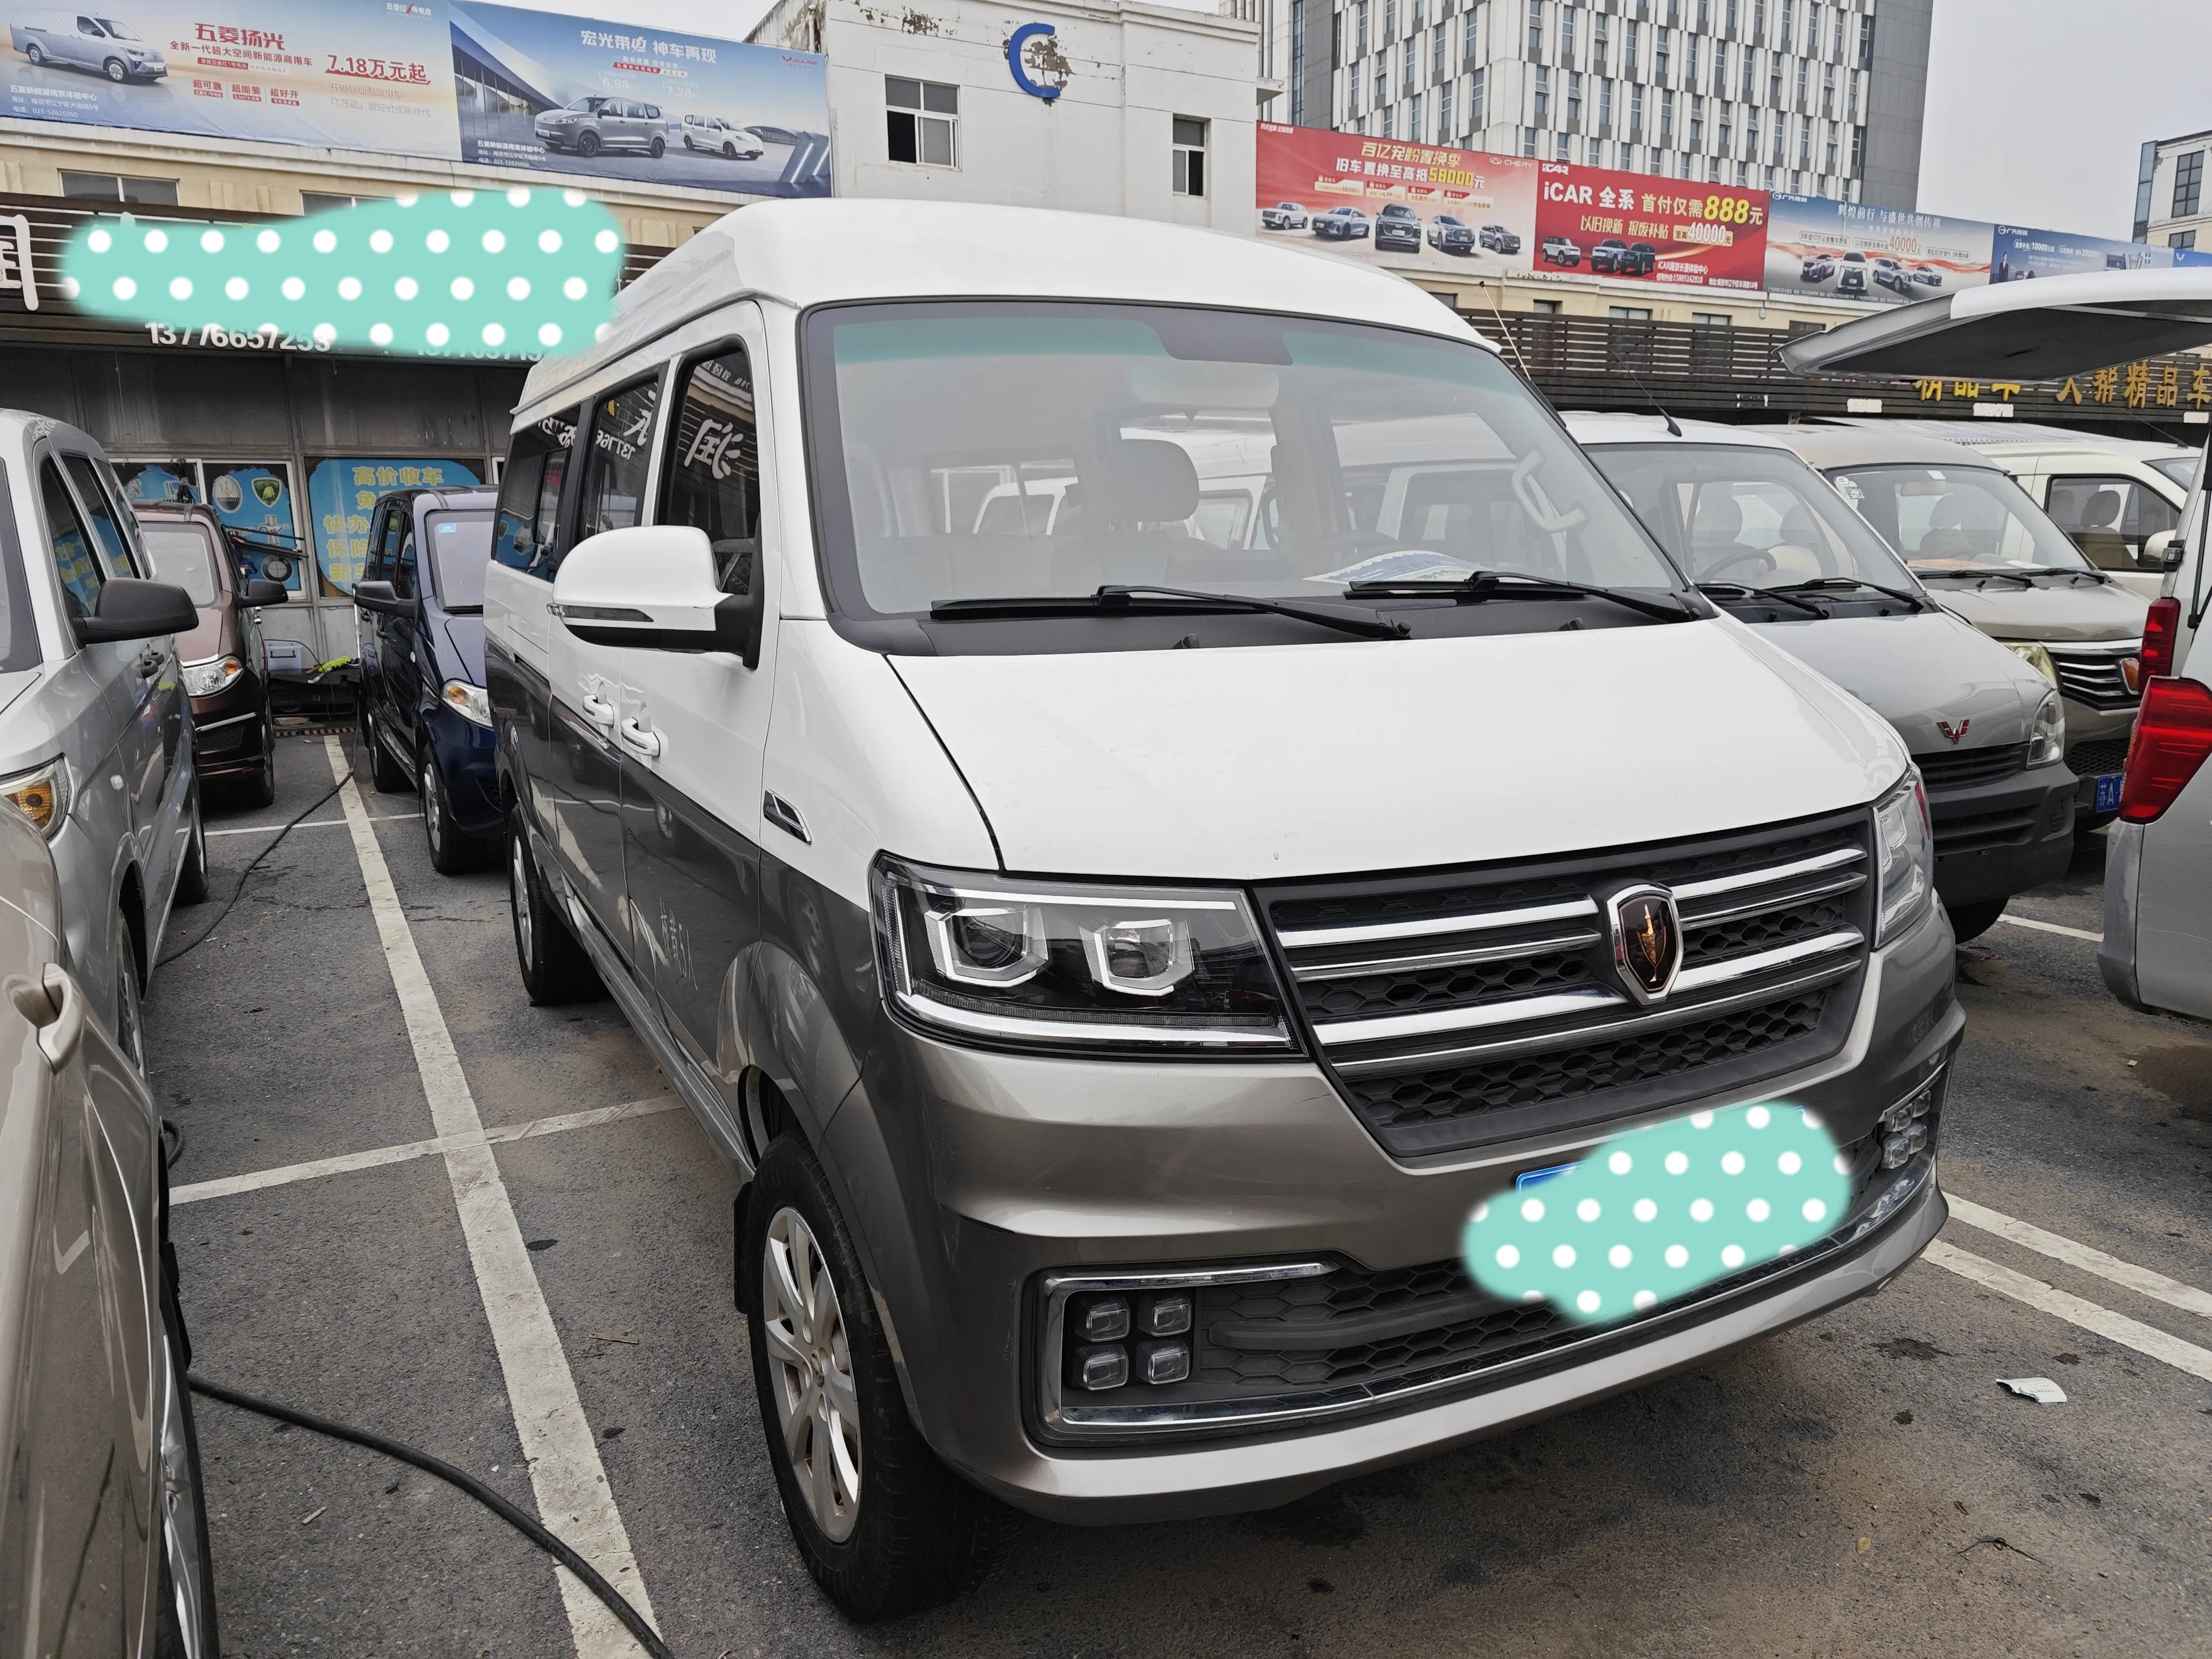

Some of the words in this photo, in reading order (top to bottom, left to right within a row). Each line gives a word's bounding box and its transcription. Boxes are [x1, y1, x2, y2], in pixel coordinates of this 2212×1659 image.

[194, 23, 285, 51] 五菱扬光
[581, 30, 647, 53] 宏光带电
[652, 40, 717, 64] 神车再现
[170, 41, 313, 66] 全新一代超大空间新能源商用车
[327, 54, 427, 82] 7.18万元起
[10, 84, 97, 101] 五菱新能源南京体验中心
[193, 79, 222, 91] 超可靠
[232, 83, 261, 95] 超能装
[270, 88, 298, 99] 超好开
[1361, 141, 1462, 167] 百亿宠粉置换季
[1504, 159, 1533, 168] CHERY
[1336, 157, 1485, 190] 旧车置换至高抵58000元
[1543, 181, 1593, 205] iCAR
[1599, 186, 1635, 211] 全系
[1642, 192, 1764, 226] 首付仅需888元
[1838, 204, 1876, 221] 辉煌前行
[1879, 210, 1941, 230] 与盛世共创传祺
[1580, 215, 1623, 235] 以旧换新
[1628, 220, 1669, 240] 报废补贴
[1675, 222, 1731, 245] 至高40000元
[352, 467, 444, 485] 高价收车
[323, 514, 372, 534] 快办
[2099, 781, 2122, 806] 苏A·
